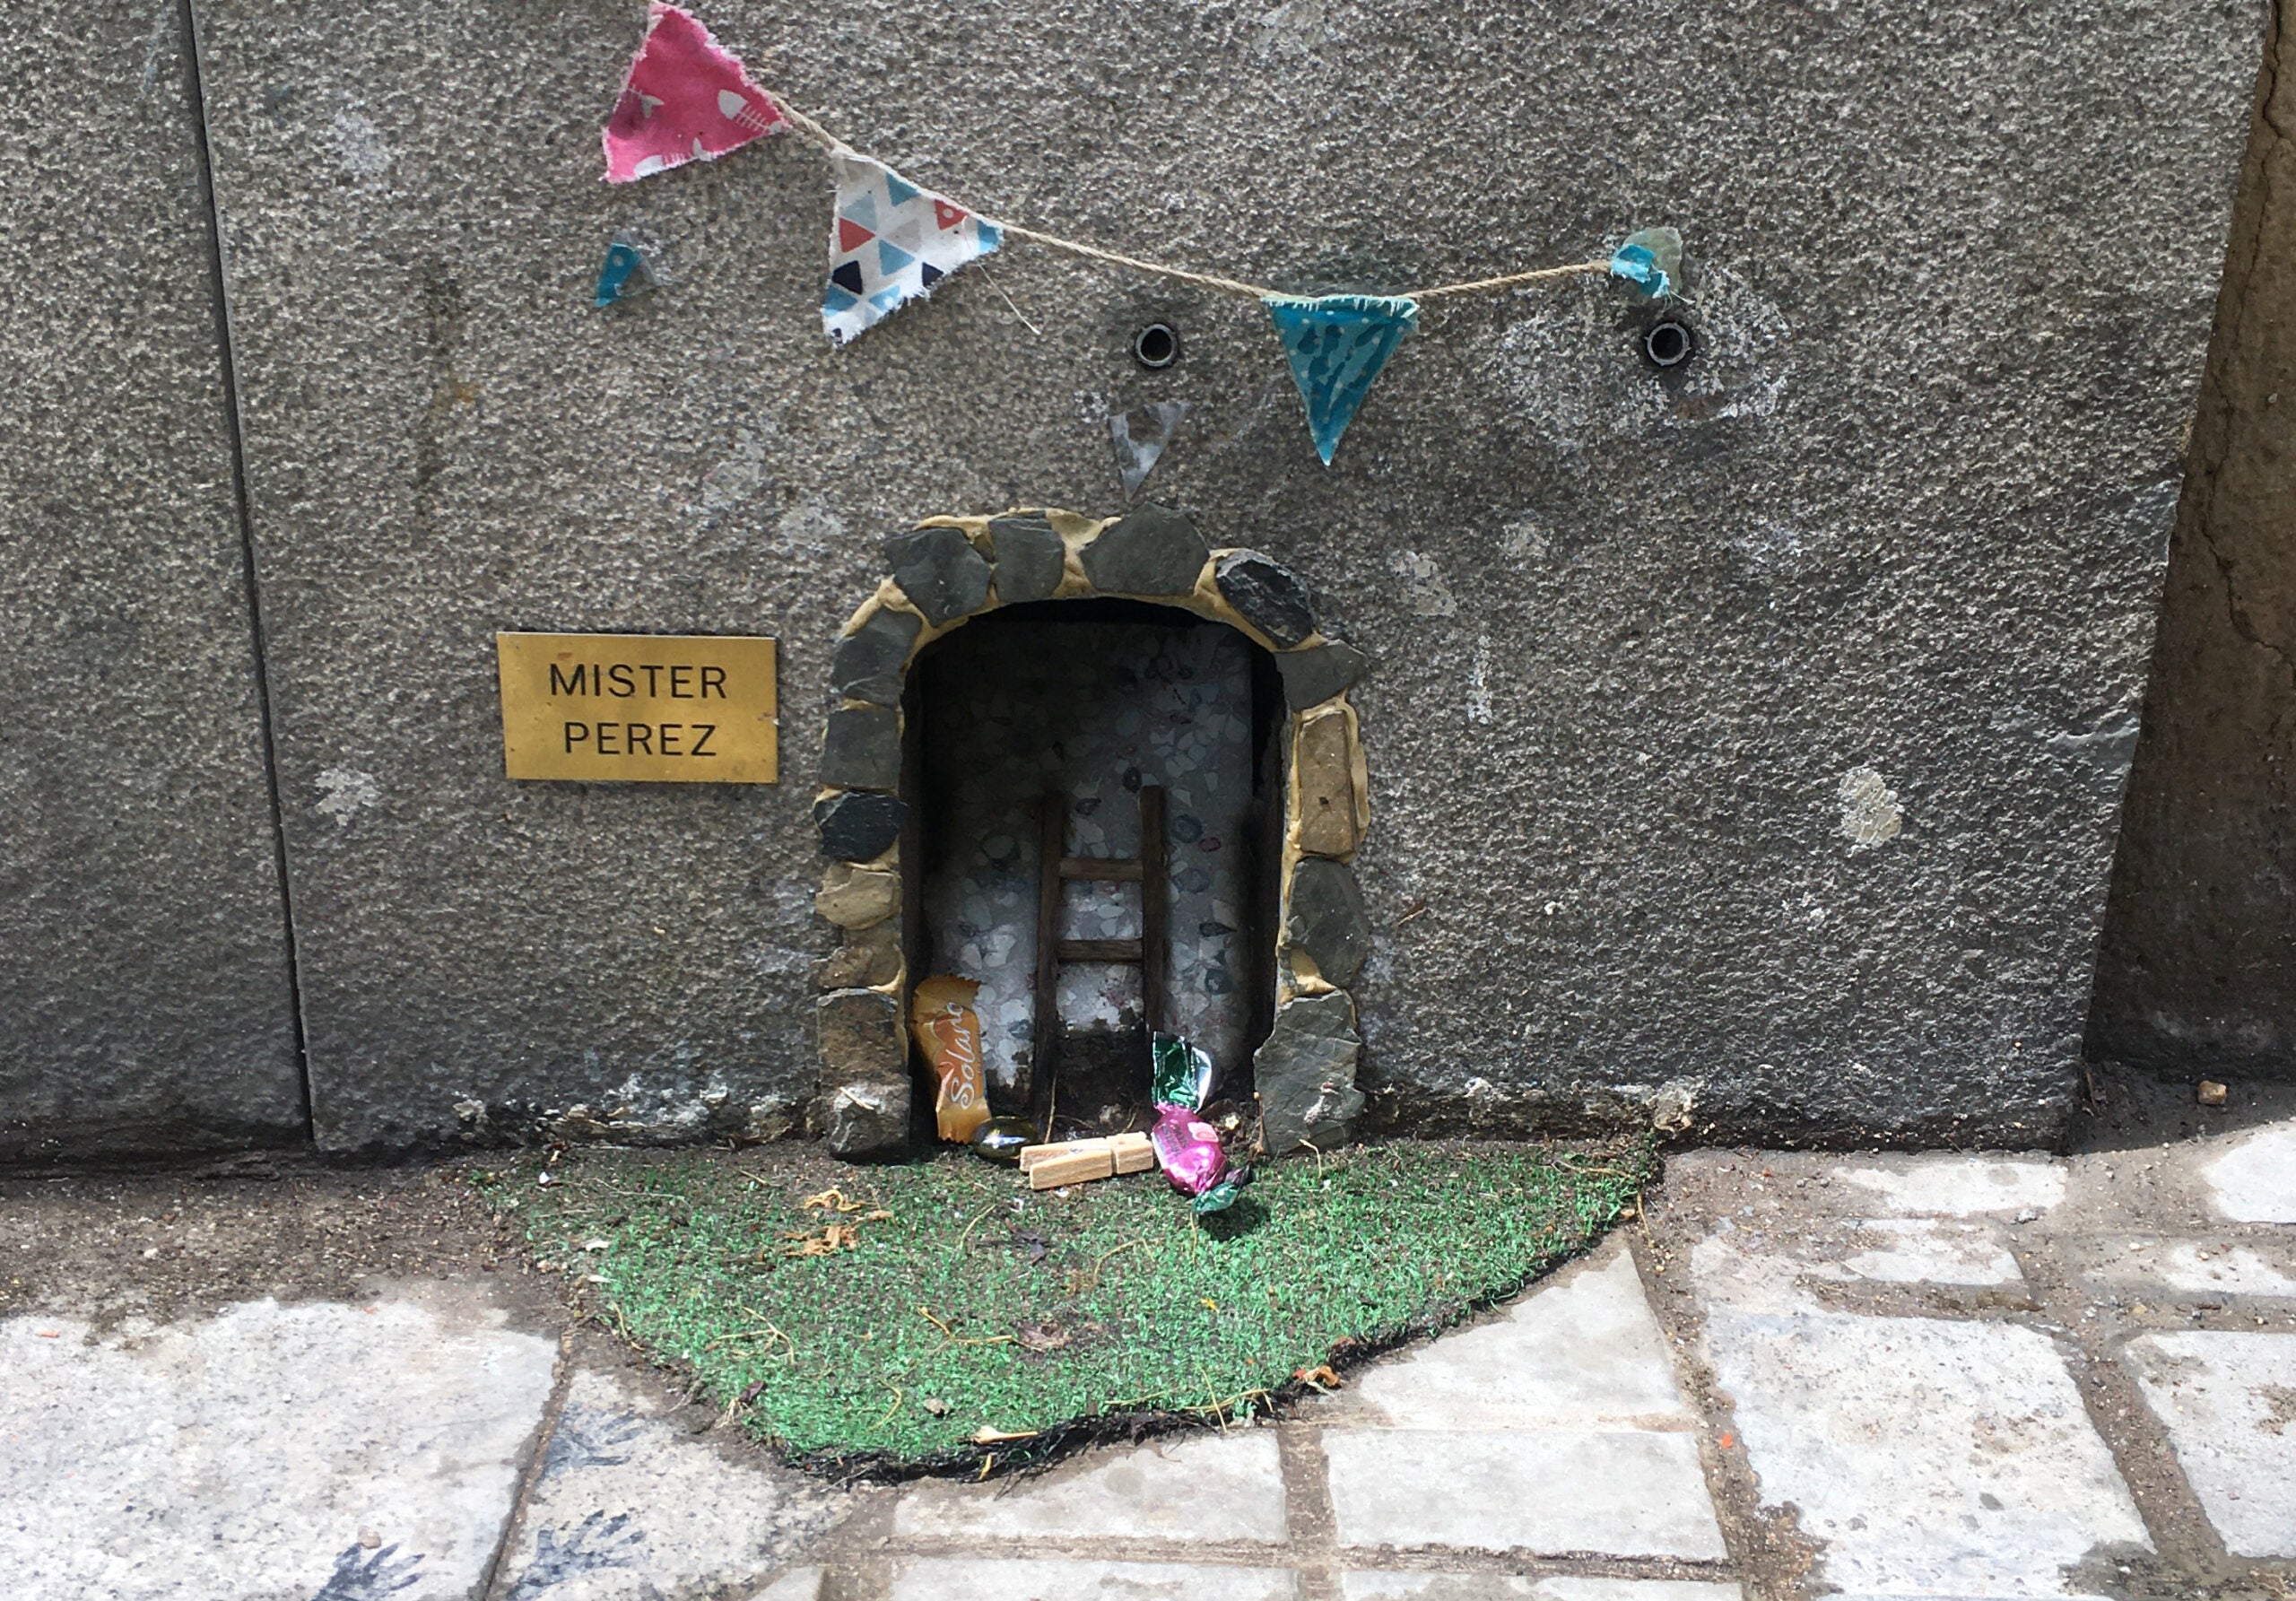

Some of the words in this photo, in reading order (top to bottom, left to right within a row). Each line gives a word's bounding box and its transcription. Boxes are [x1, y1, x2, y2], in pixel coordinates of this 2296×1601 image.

[550, 663, 727, 699] MISTER
[564, 721, 717, 756] PEREZ
[945, 1001, 977, 1110] Solano
